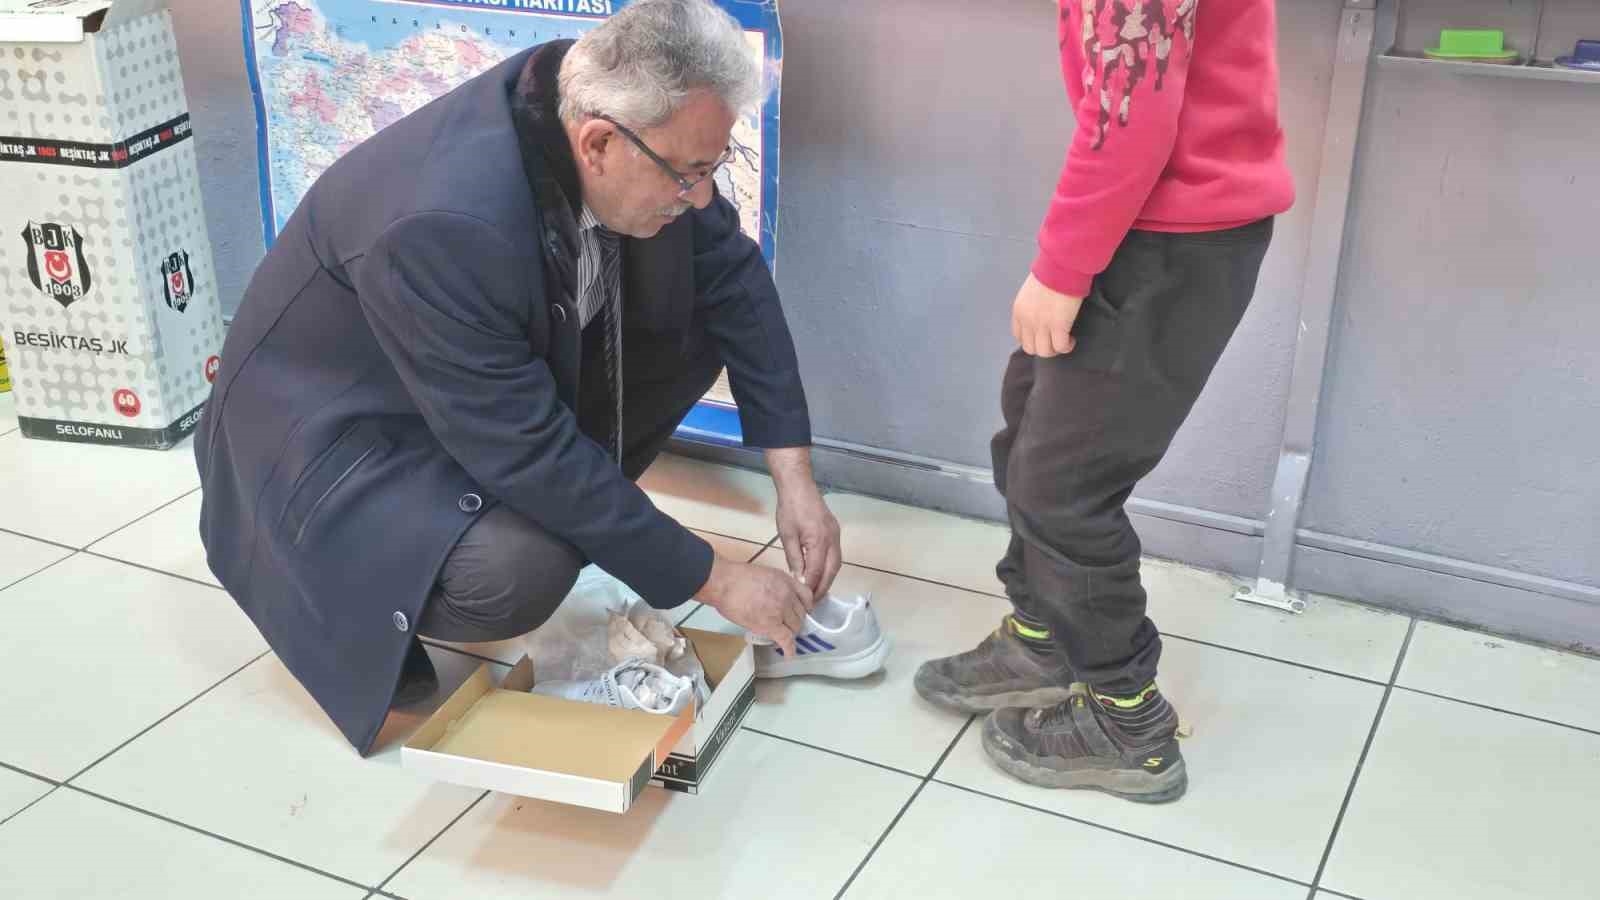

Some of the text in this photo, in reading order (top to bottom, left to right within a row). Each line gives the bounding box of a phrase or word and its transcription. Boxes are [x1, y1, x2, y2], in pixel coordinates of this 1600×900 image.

[98, 151, 110, 161] JK
[31, 228, 75, 249] BJK
[45, 283, 81, 297] 1903
[14, 331, 129, 356] BEŞİKTAŞ JK
[118, 393, 137, 406] 60
[55, 424, 123, 440] SELOFANLI
